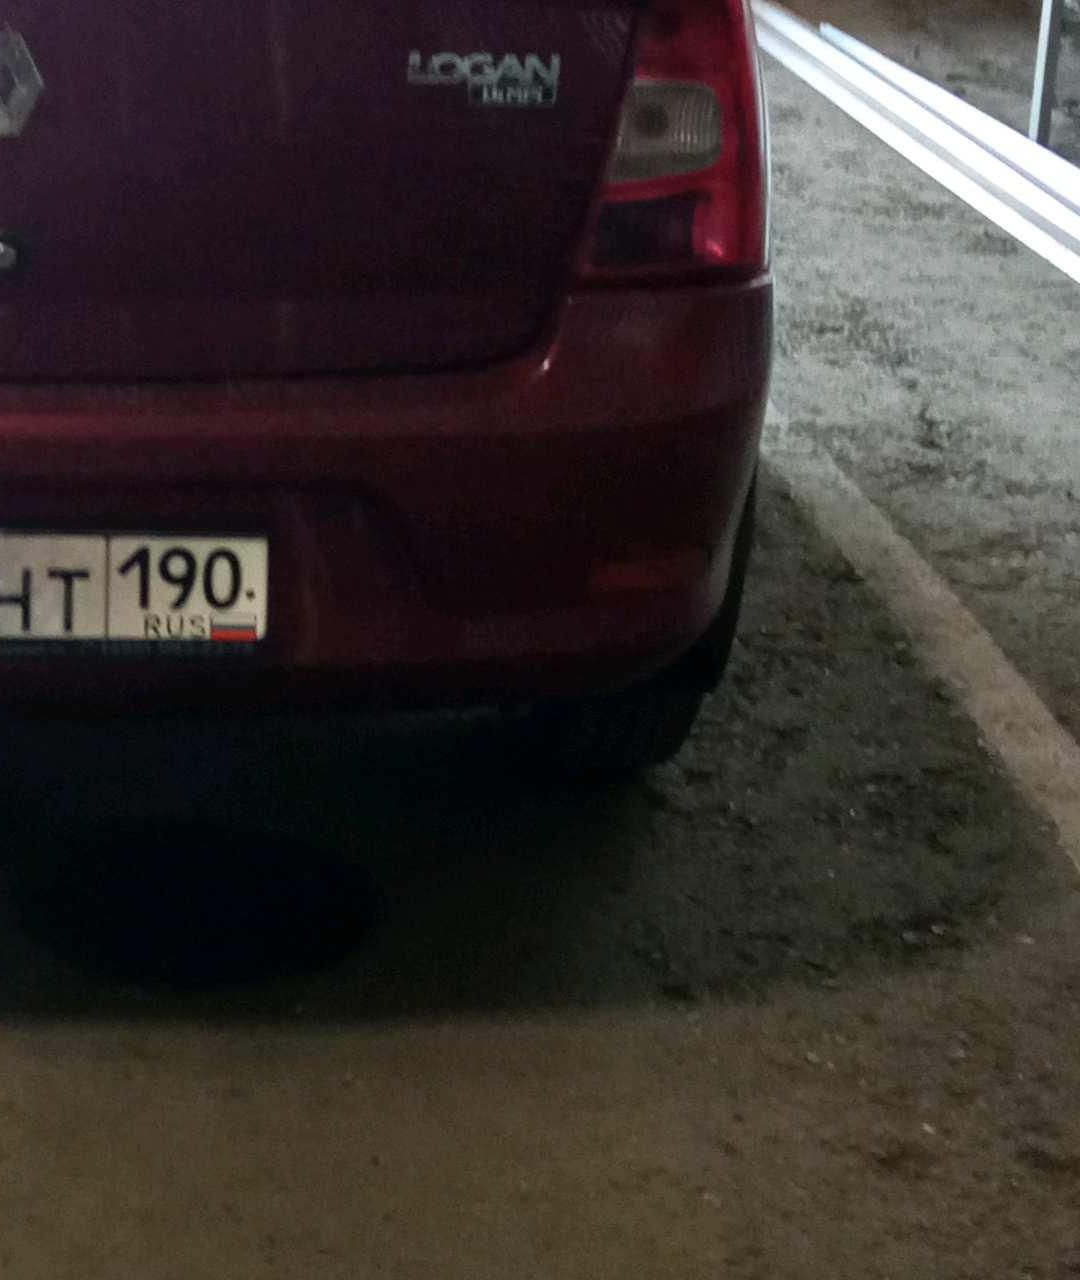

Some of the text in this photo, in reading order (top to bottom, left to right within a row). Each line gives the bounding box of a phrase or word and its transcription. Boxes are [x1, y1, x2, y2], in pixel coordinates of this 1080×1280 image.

[407, 49, 561, 87] LOGAN
[118, 545, 242, 610] 190
[144, 613, 206, 639] RUS
